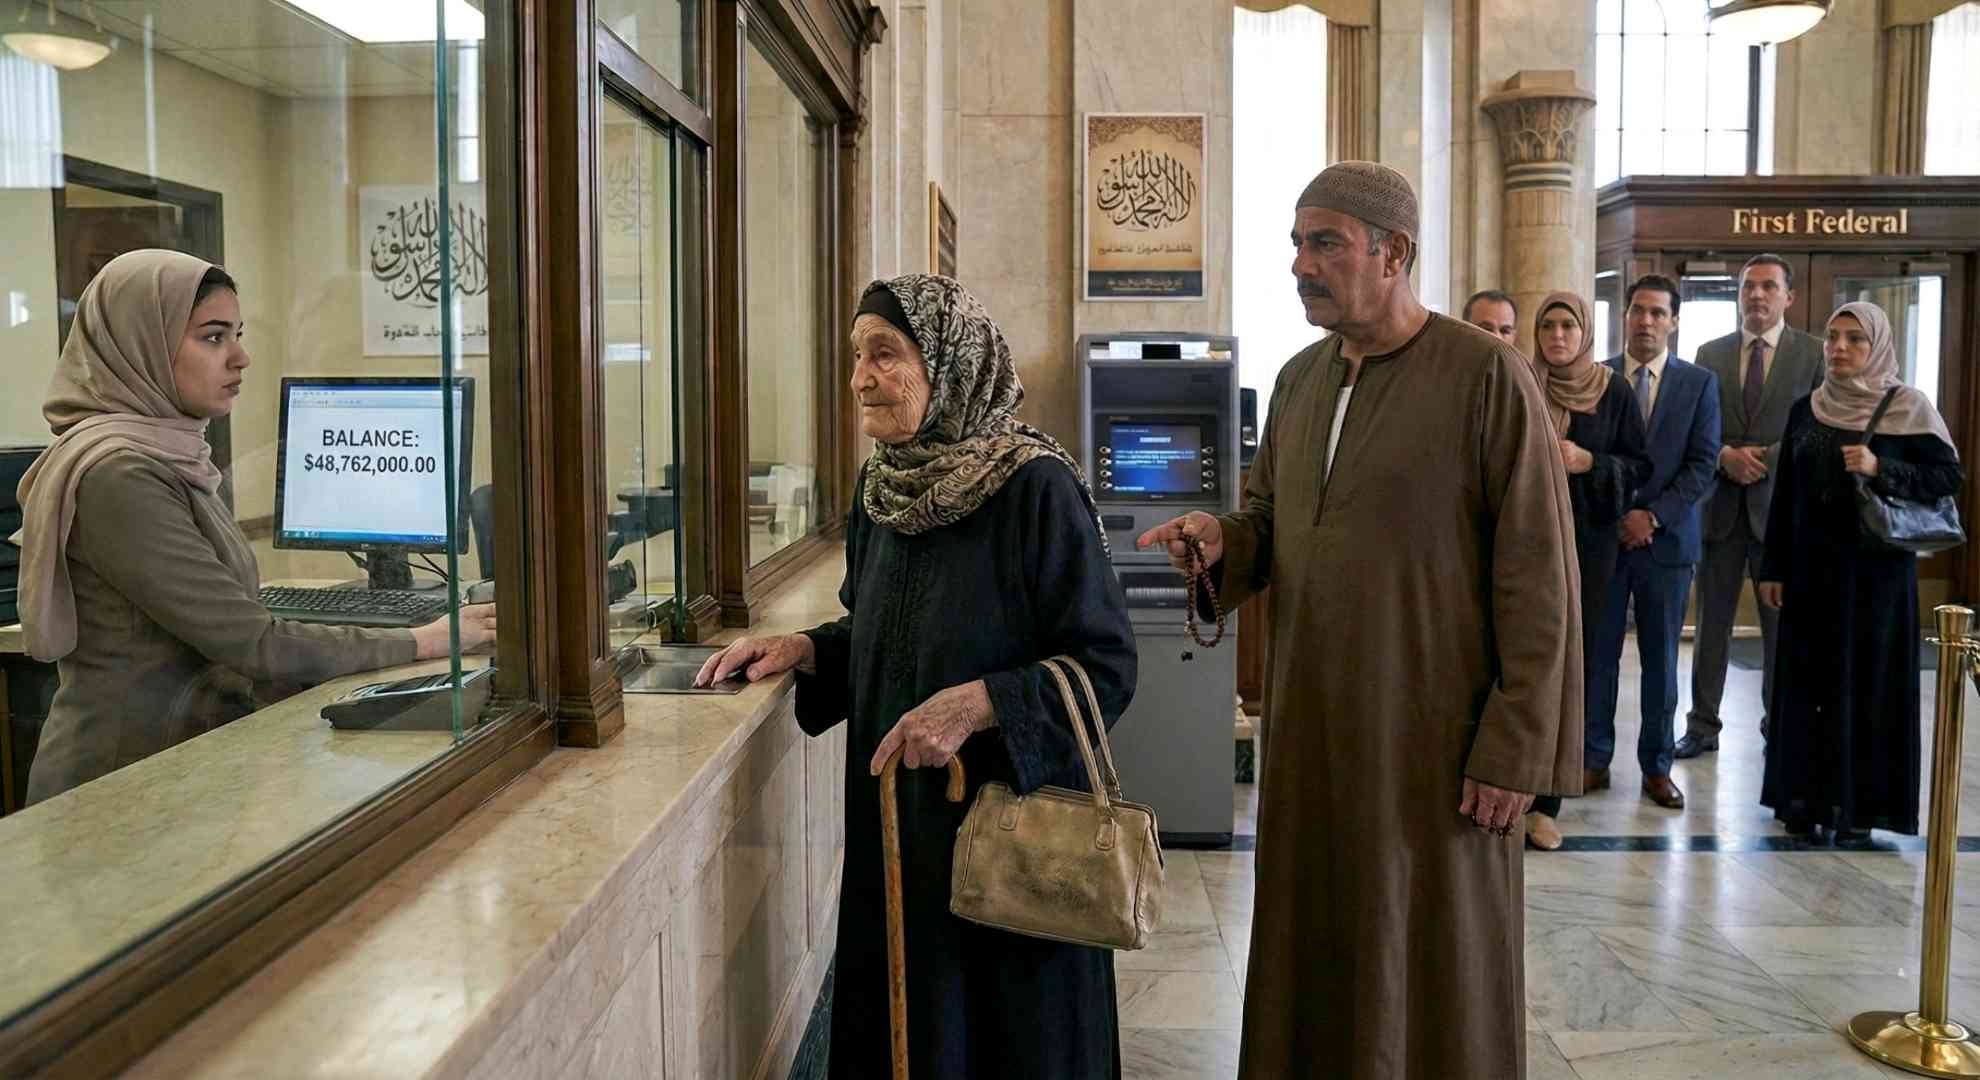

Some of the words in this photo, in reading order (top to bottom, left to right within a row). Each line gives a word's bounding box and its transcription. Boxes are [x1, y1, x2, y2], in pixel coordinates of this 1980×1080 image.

[1732, 208, 1797, 234] First
[1805, 208, 1908, 234] Federal
[322, 429, 420, 447] BALANCE:
[304, 453, 436, 476] $48,762,000.00
